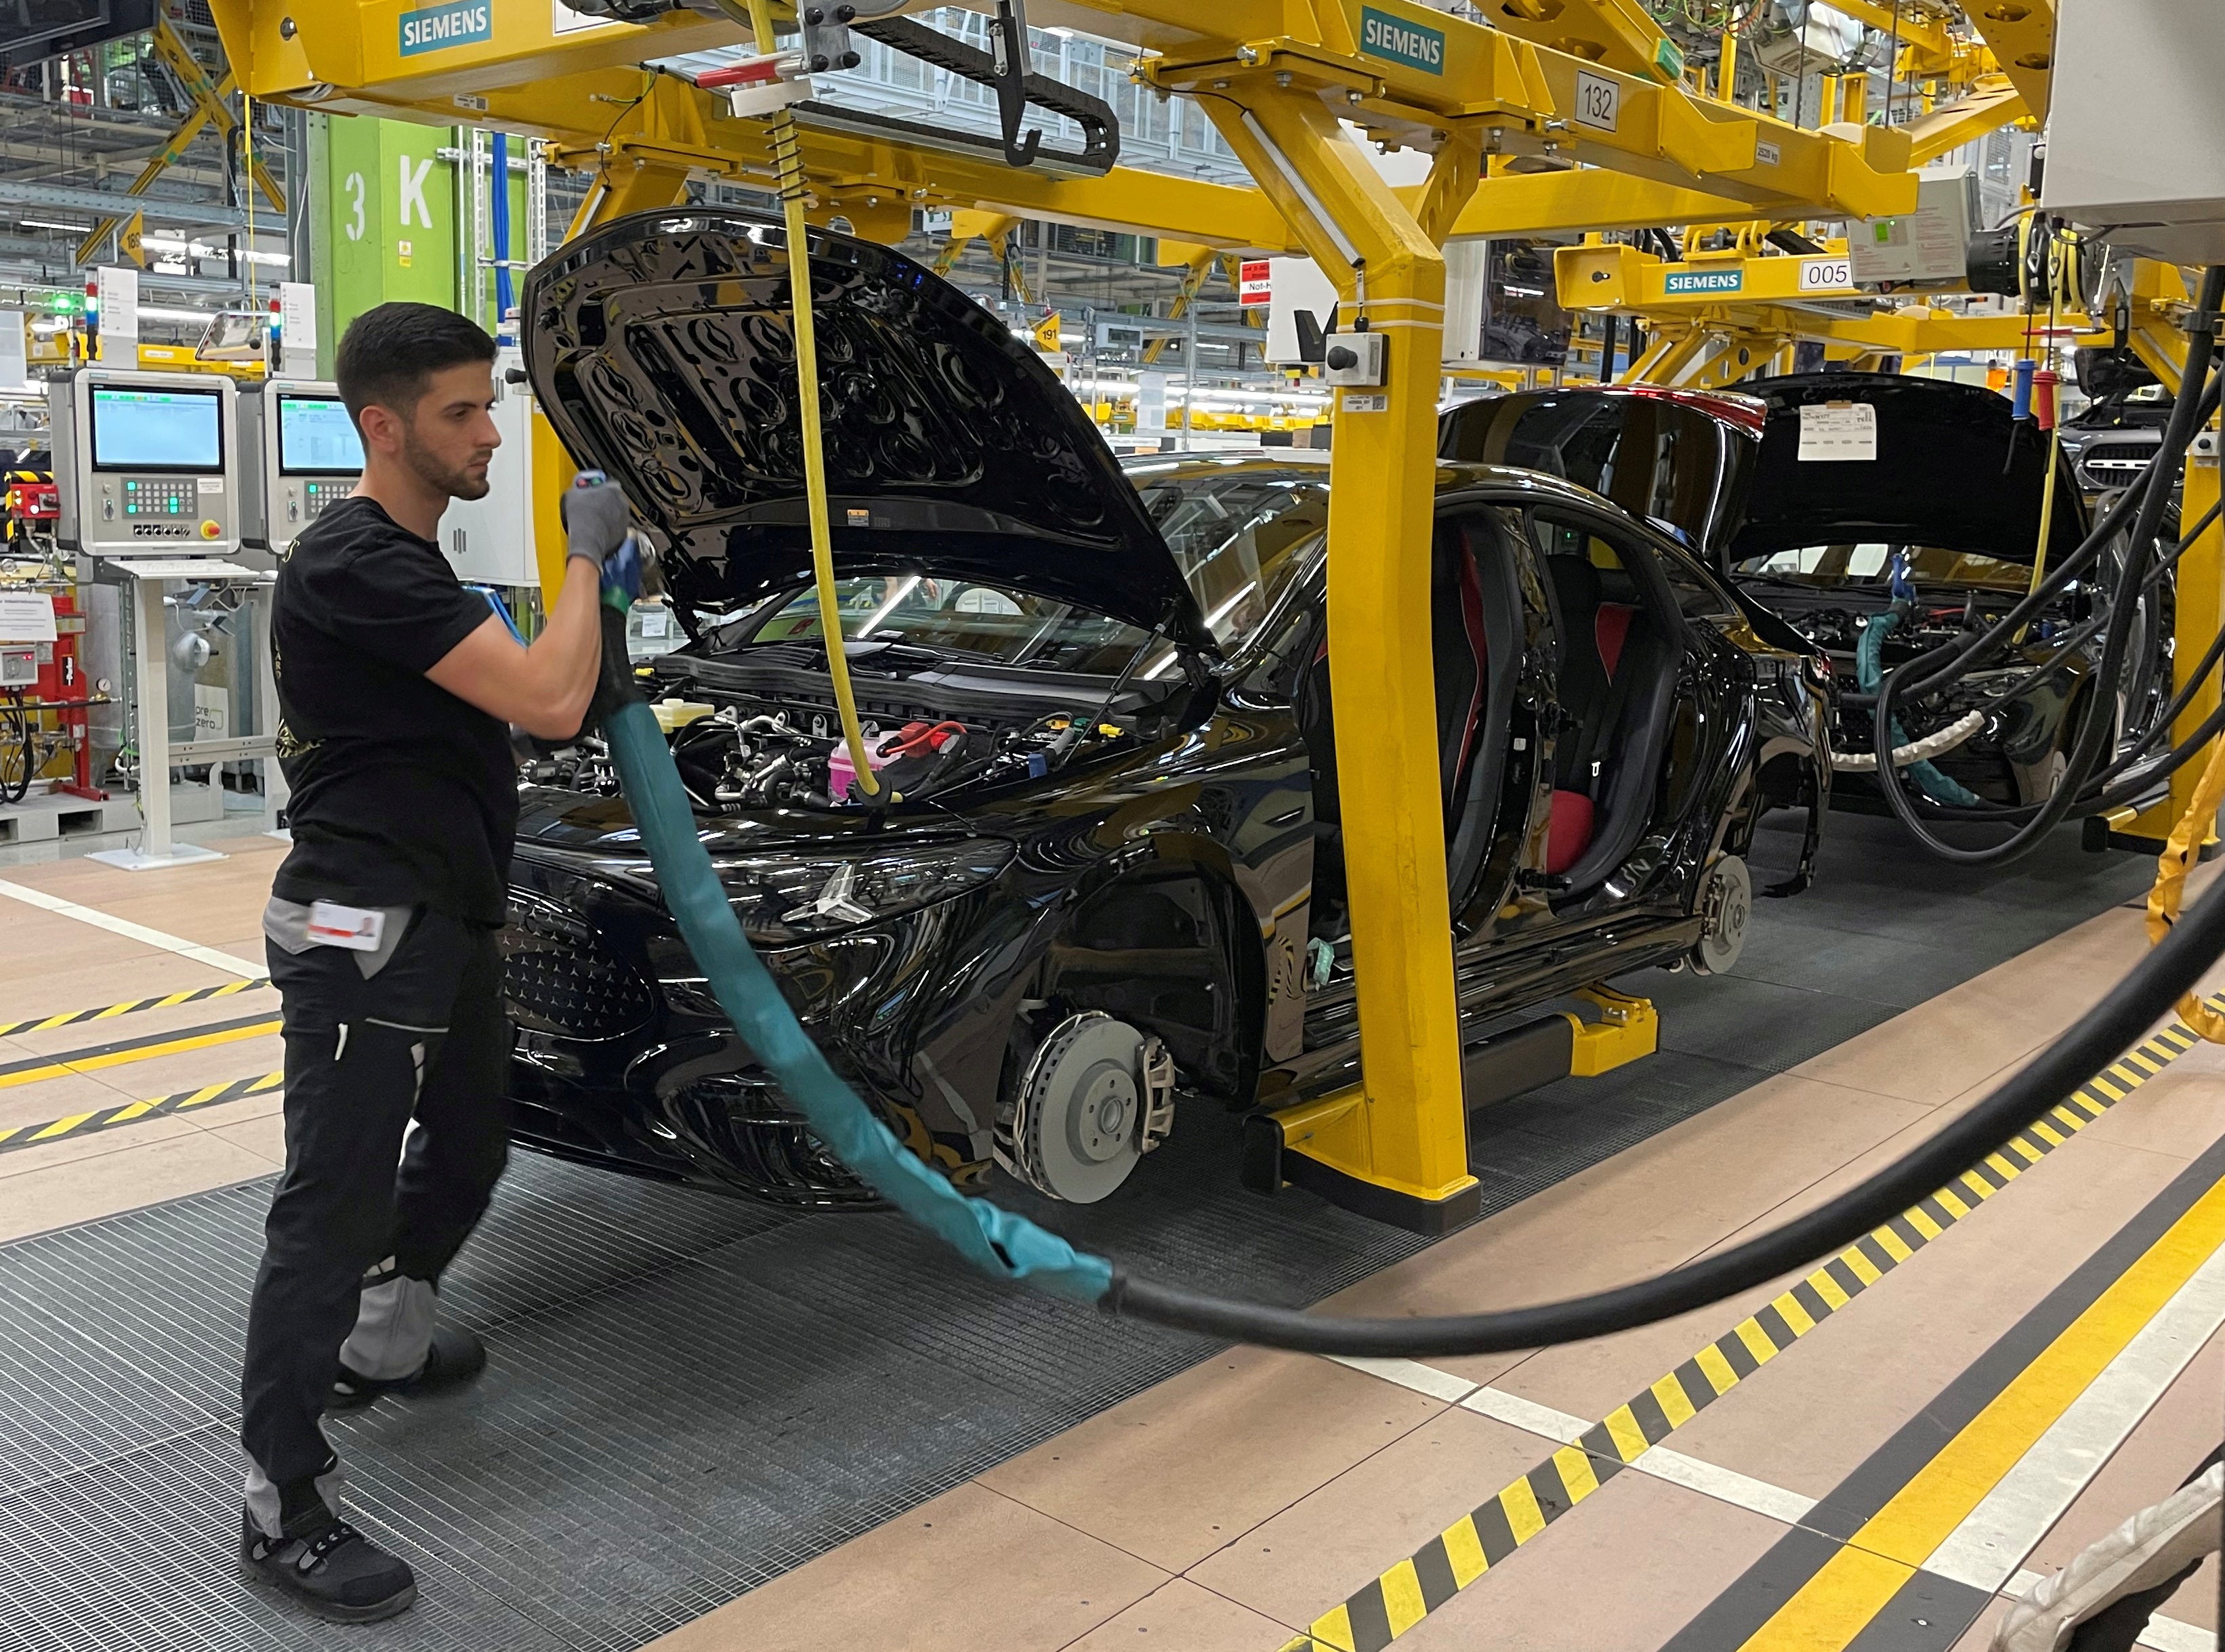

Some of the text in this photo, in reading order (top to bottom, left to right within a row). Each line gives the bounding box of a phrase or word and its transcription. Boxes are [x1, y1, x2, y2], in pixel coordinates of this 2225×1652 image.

[404, 6, 487, 46] SIEMENS
[1365, 18, 1440, 64] SIEMENS
[1585, 83, 1612, 121] 132
[400, 154, 434, 229] K
[345, 171, 365, 241] 3
[1669, 274, 1738, 290] SIEMENS
[1808, 265, 1848, 284] 005
[1042, 329, 1057, 341] 191
[196, 705, 209, 717] pre
[196, 717, 216, 729] zero
